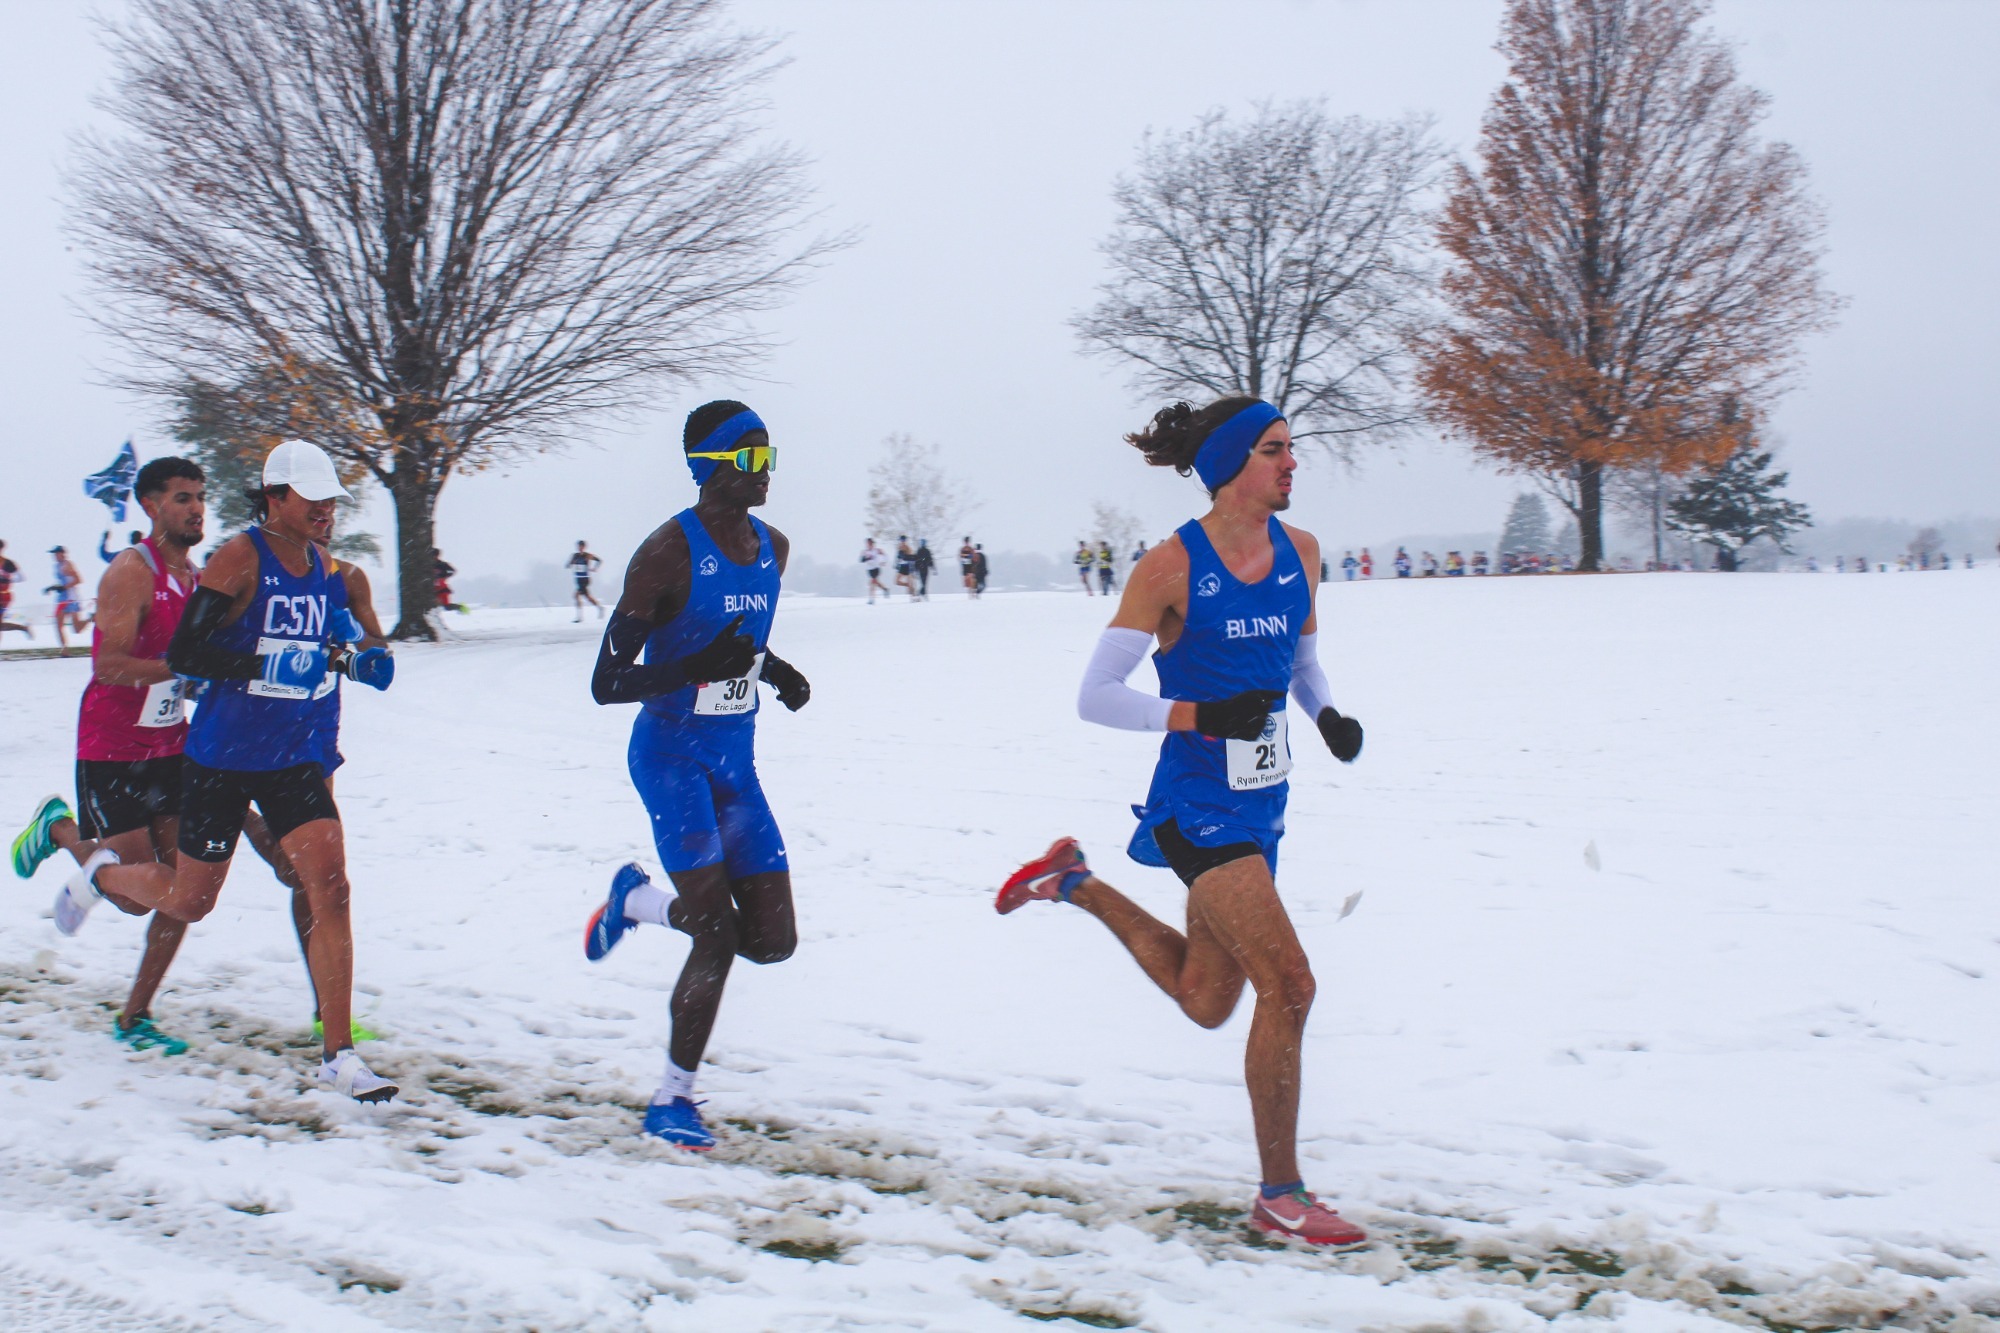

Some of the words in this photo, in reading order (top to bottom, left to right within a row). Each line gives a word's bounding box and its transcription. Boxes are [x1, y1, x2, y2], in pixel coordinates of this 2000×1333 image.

[723, 593, 768, 613] BLINN
[263, 595, 327, 636] CSN
[1225, 614, 1288, 639] BLINN
[261, 684, 291, 695] Dominic
[723, 679, 749, 701] 30
[714, 703, 729, 711] Eric
[1255, 743, 1276, 770] 25
[1236, 776, 1258, 787] Ryan
